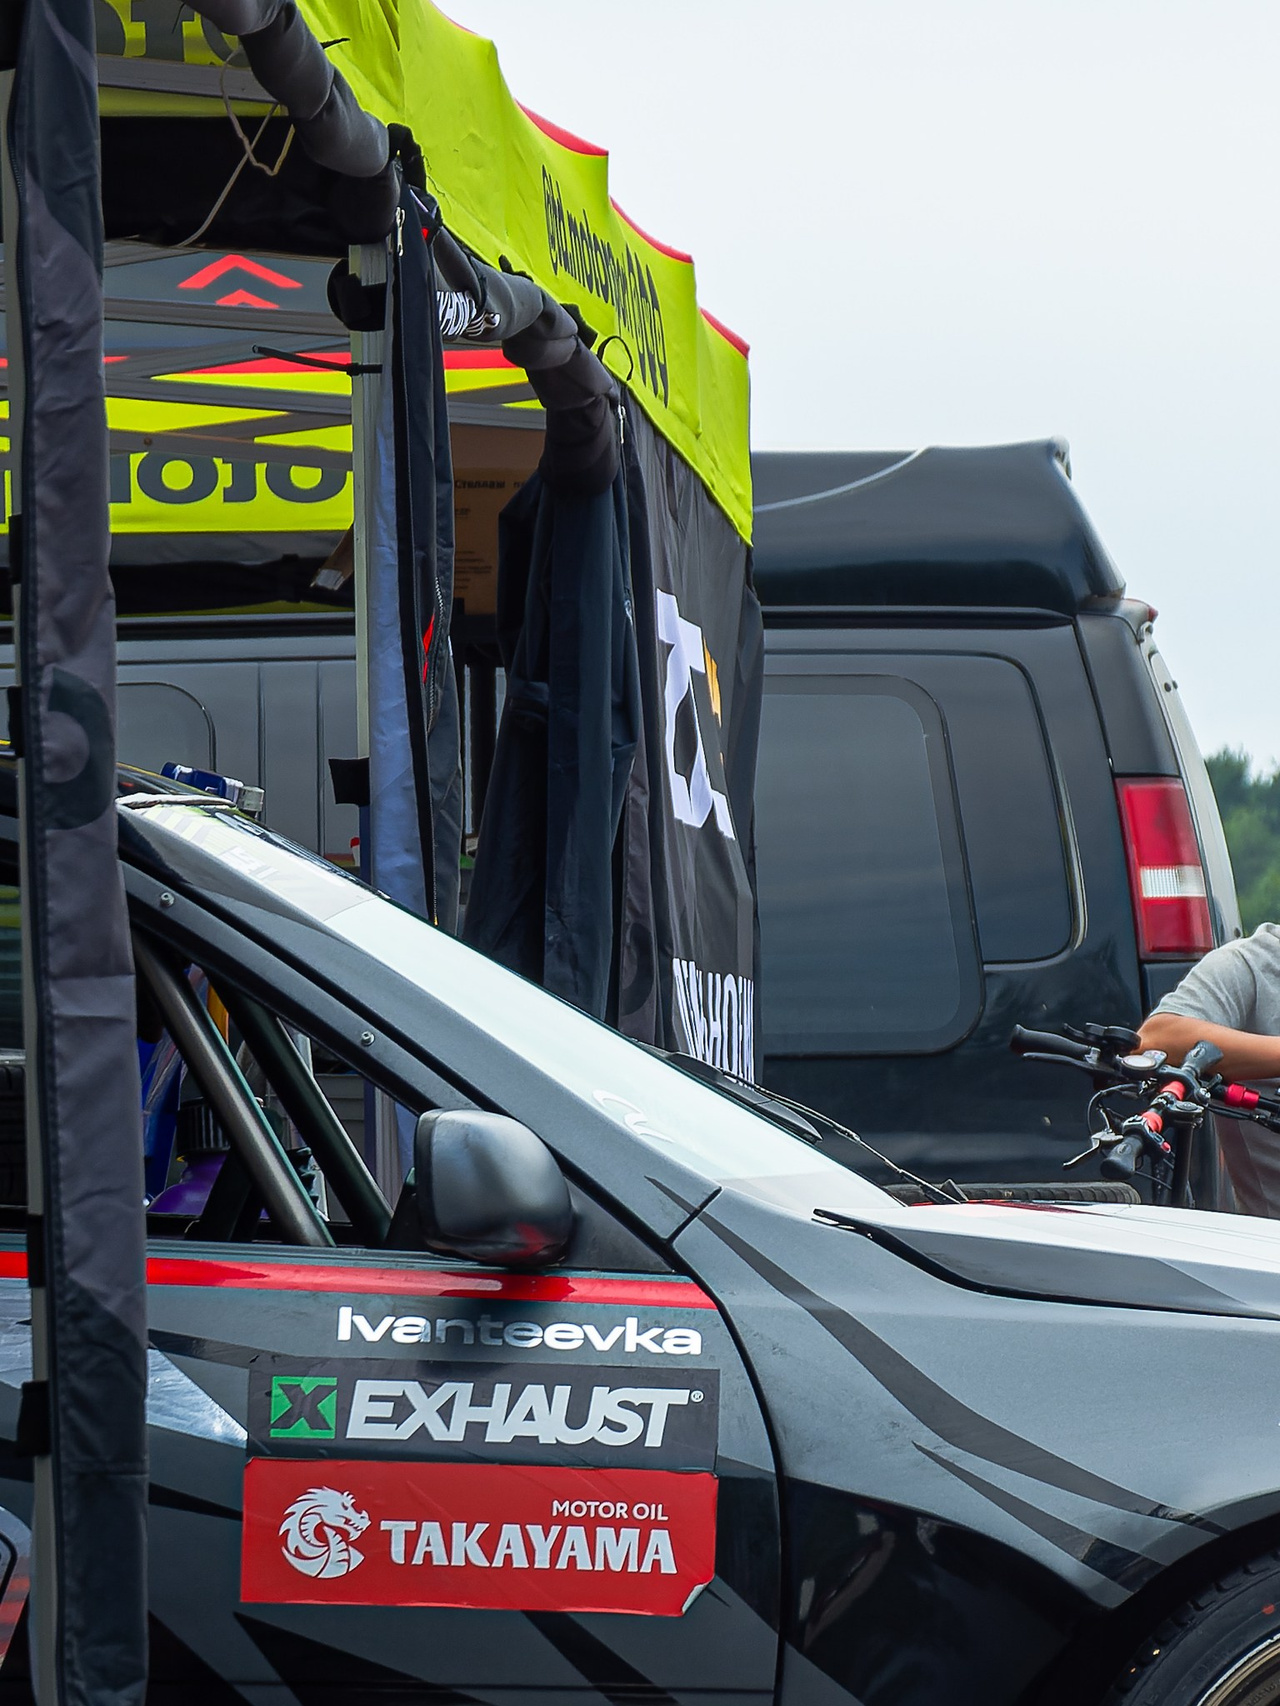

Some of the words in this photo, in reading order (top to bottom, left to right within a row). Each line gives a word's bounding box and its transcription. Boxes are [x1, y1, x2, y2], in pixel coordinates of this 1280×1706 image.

[337, 1306, 702, 1355] Ivanteevka
[346, 1379, 691, 1448] EXHAUST
[552, 1499, 629, 1520] MOTOR
[636, 1503, 669, 1521] OIL
[380, 1521, 677, 1574] TAKAYAMA
